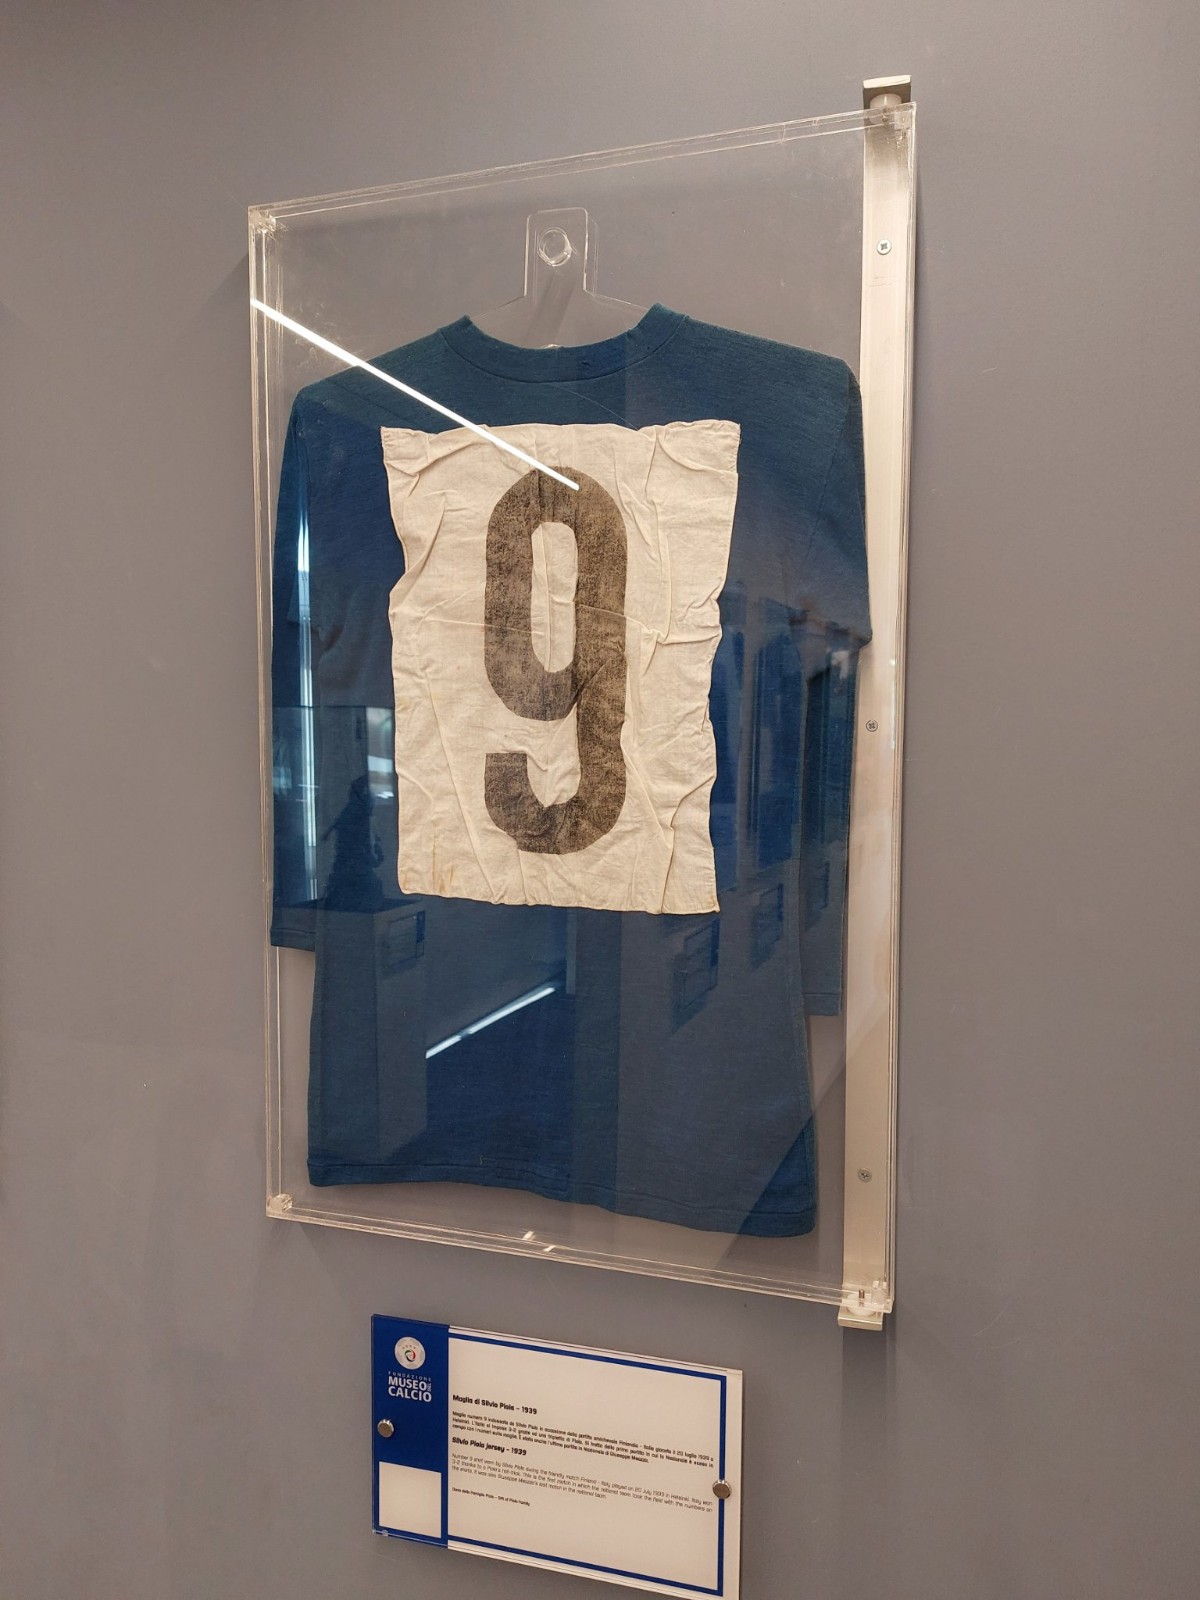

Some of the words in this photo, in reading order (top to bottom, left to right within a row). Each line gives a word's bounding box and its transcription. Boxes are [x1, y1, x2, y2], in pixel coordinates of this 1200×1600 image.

[484, 466, 628, 855] 9
[388, 1371, 432, 1382] FONDAZIONE
[388, 1376, 427, 1391] MUSEO
[388, 1386, 432, 1402] CALCIO
[452, 1394, 473, 1404] Maglia
[481, 1399, 498, 1407] Silvio
[499, 1402, 515, 1410] Piola
[521, 1406, 537, 1414] 1939
[452, 1436, 469, 1445] Silvio
[469, 1439, 484, 1448] Piola
[485, 1442, 505, 1453] jersey
[511, 1447, 527, 1455] 1939
